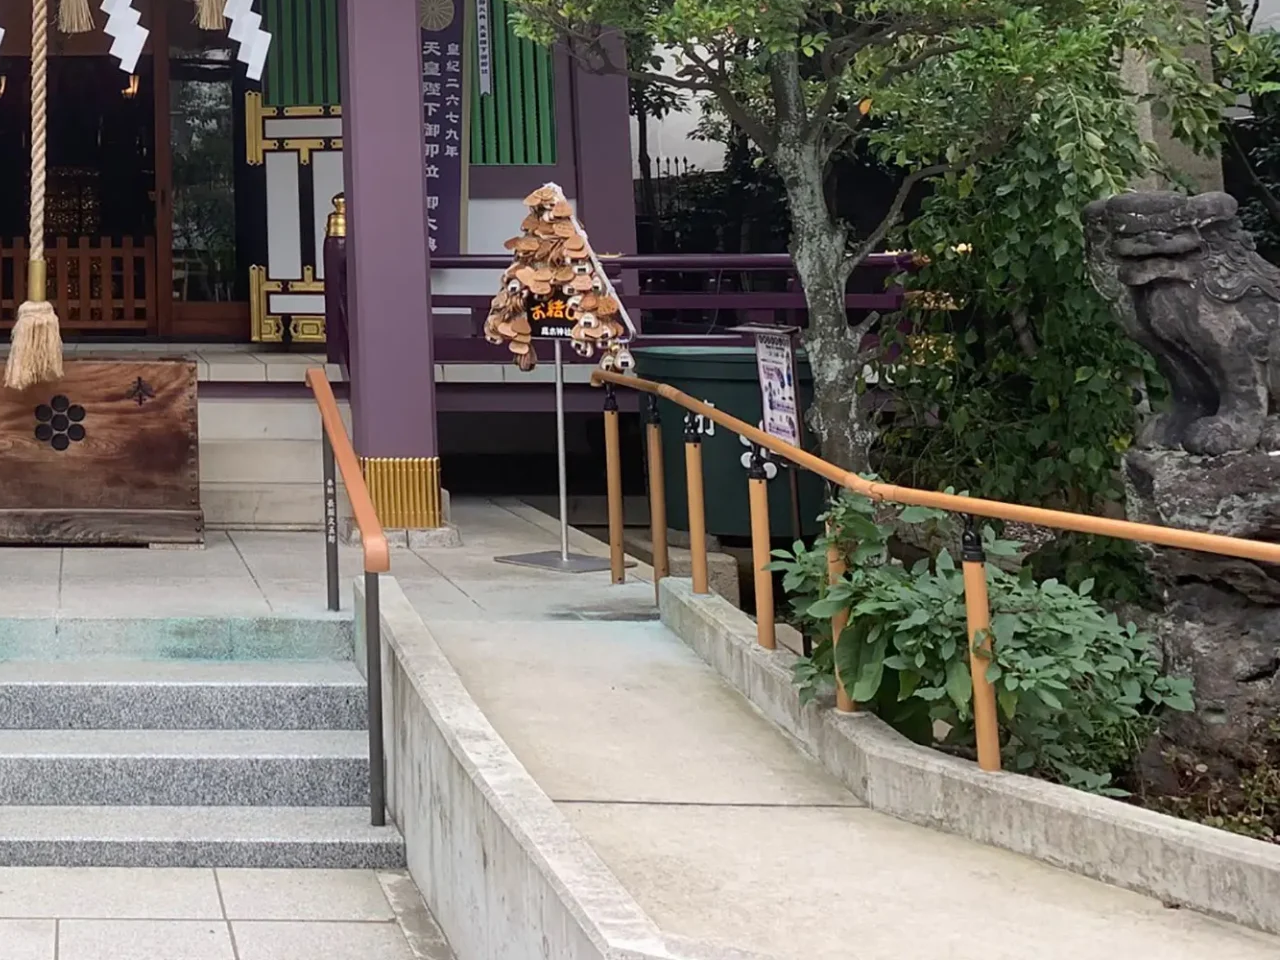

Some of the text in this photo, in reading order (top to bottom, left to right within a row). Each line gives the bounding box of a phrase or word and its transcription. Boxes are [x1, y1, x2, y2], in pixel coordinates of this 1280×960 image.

[444, 41, 461, 158] 皇紀二六七九年
